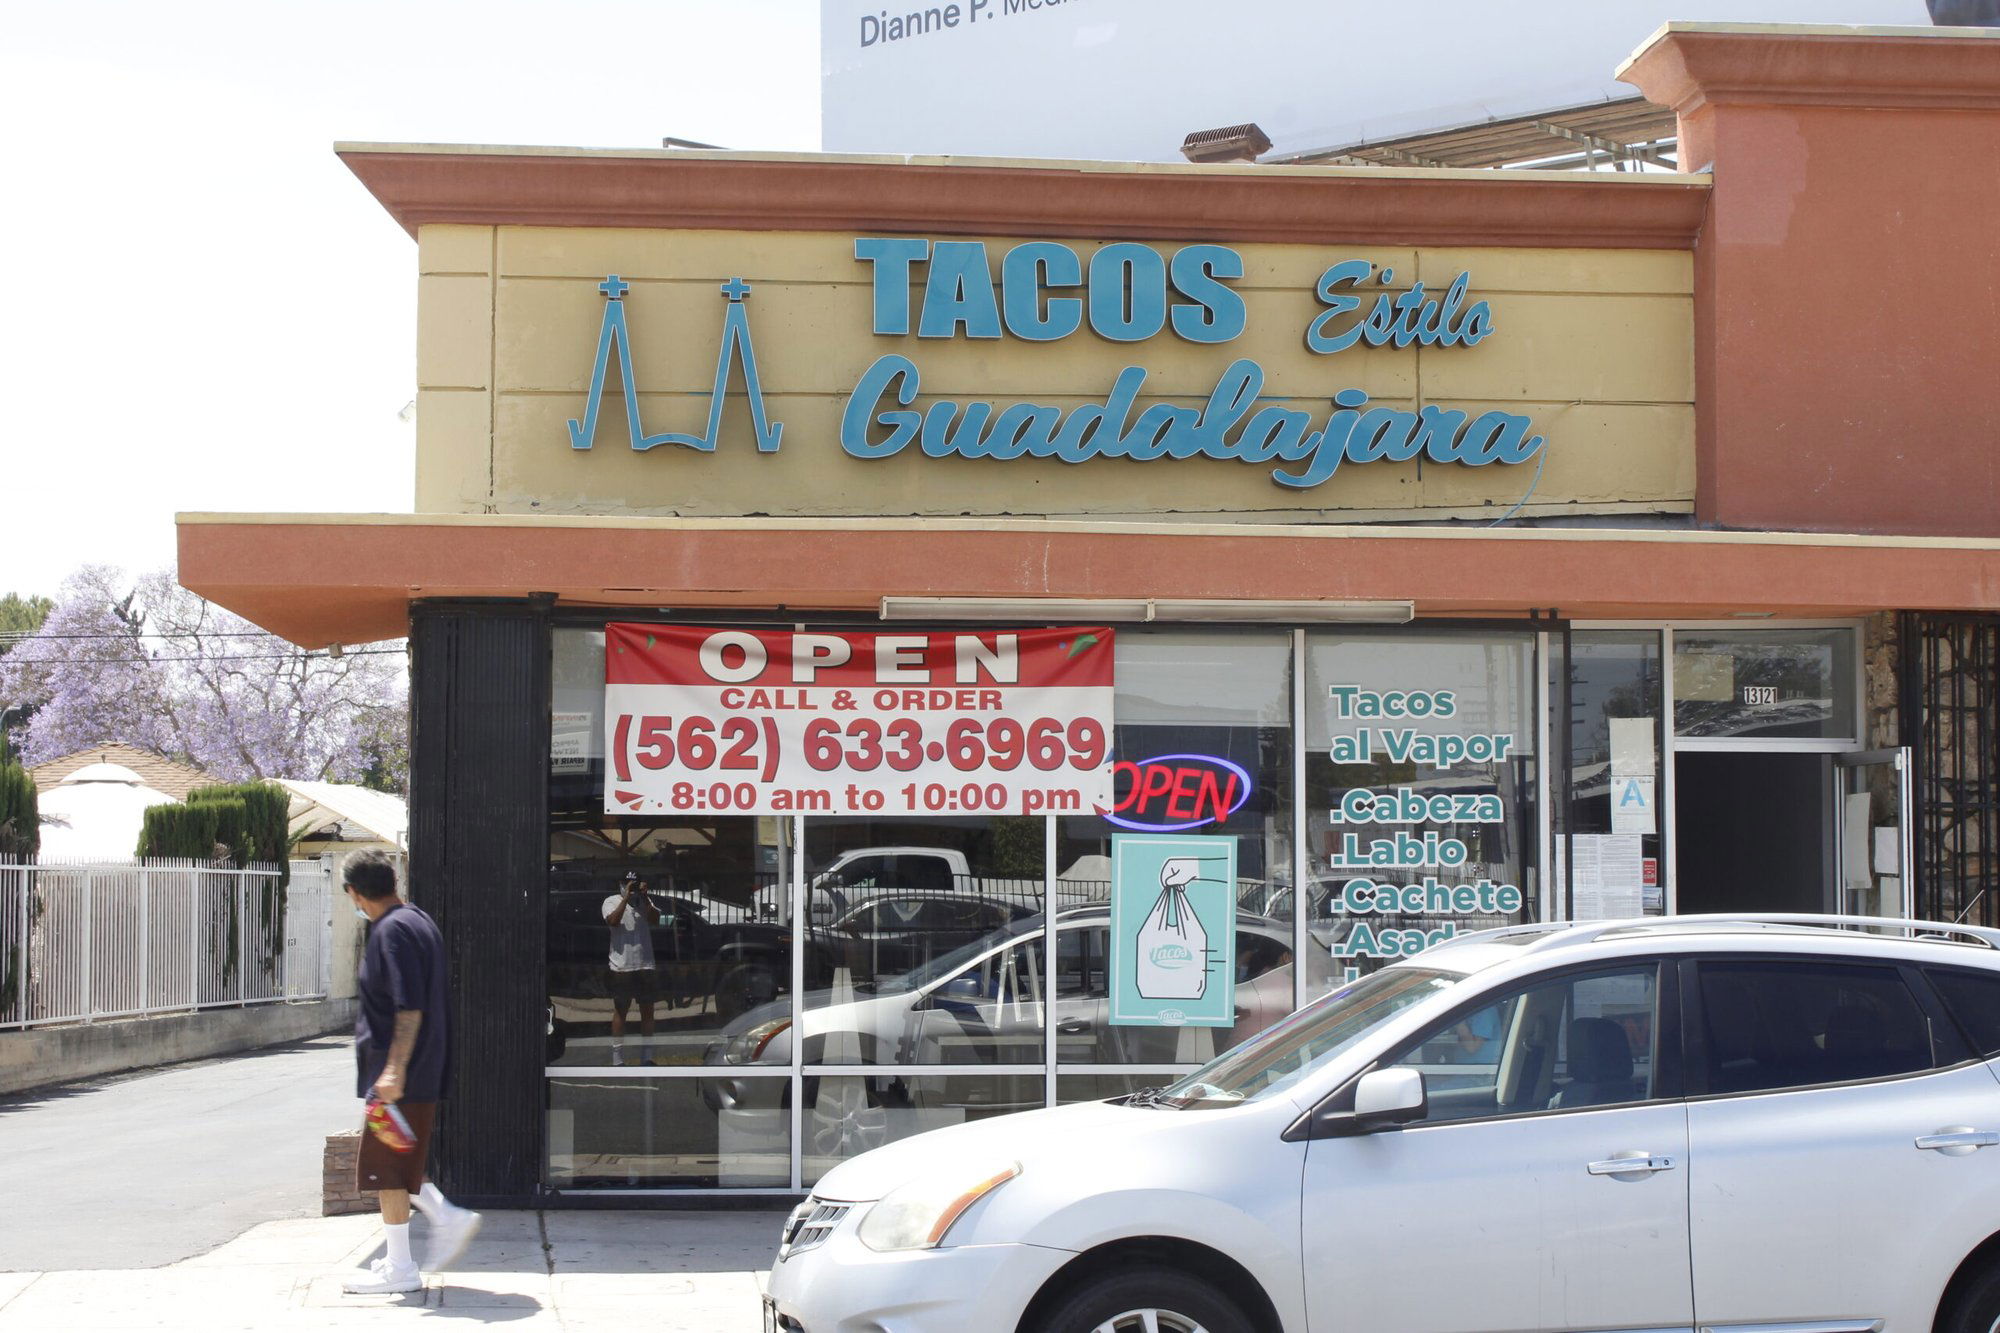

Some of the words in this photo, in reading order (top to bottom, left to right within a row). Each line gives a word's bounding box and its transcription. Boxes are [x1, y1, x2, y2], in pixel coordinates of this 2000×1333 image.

[861, 4, 960, 47] Dianne
[855, 237, 1247, 344] TACOS
[1305, 258, 1495, 355] Estilo
[840, 354, 1546, 489] Guadalajara
[699, 630, 1019, 684] OPEN
[720, 688, 818, 711] CALL
[831, 689, 859, 711] &
[873, 690, 1003, 711] ORDER
[1329, 685, 1457, 719] Tacos
[1745, 687, 1778, 704] 13121
[614, 714, 780, 783] (562)
[1330, 728, 1371, 764] al
[1379, 728, 1513, 769] Vapor
[671, 782, 758, 810] 8:00
[771, 788, 831, 810] am
[846, 784, 885, 810] to
[902, 783, 1008, 811] 10:00
[1022, 788, 1081, 815] pm
[1114, 760, 1238, 823] OPEN
[1619, 779, 1646, 807] A
[1151, 946, 1188, 960] Tacos
